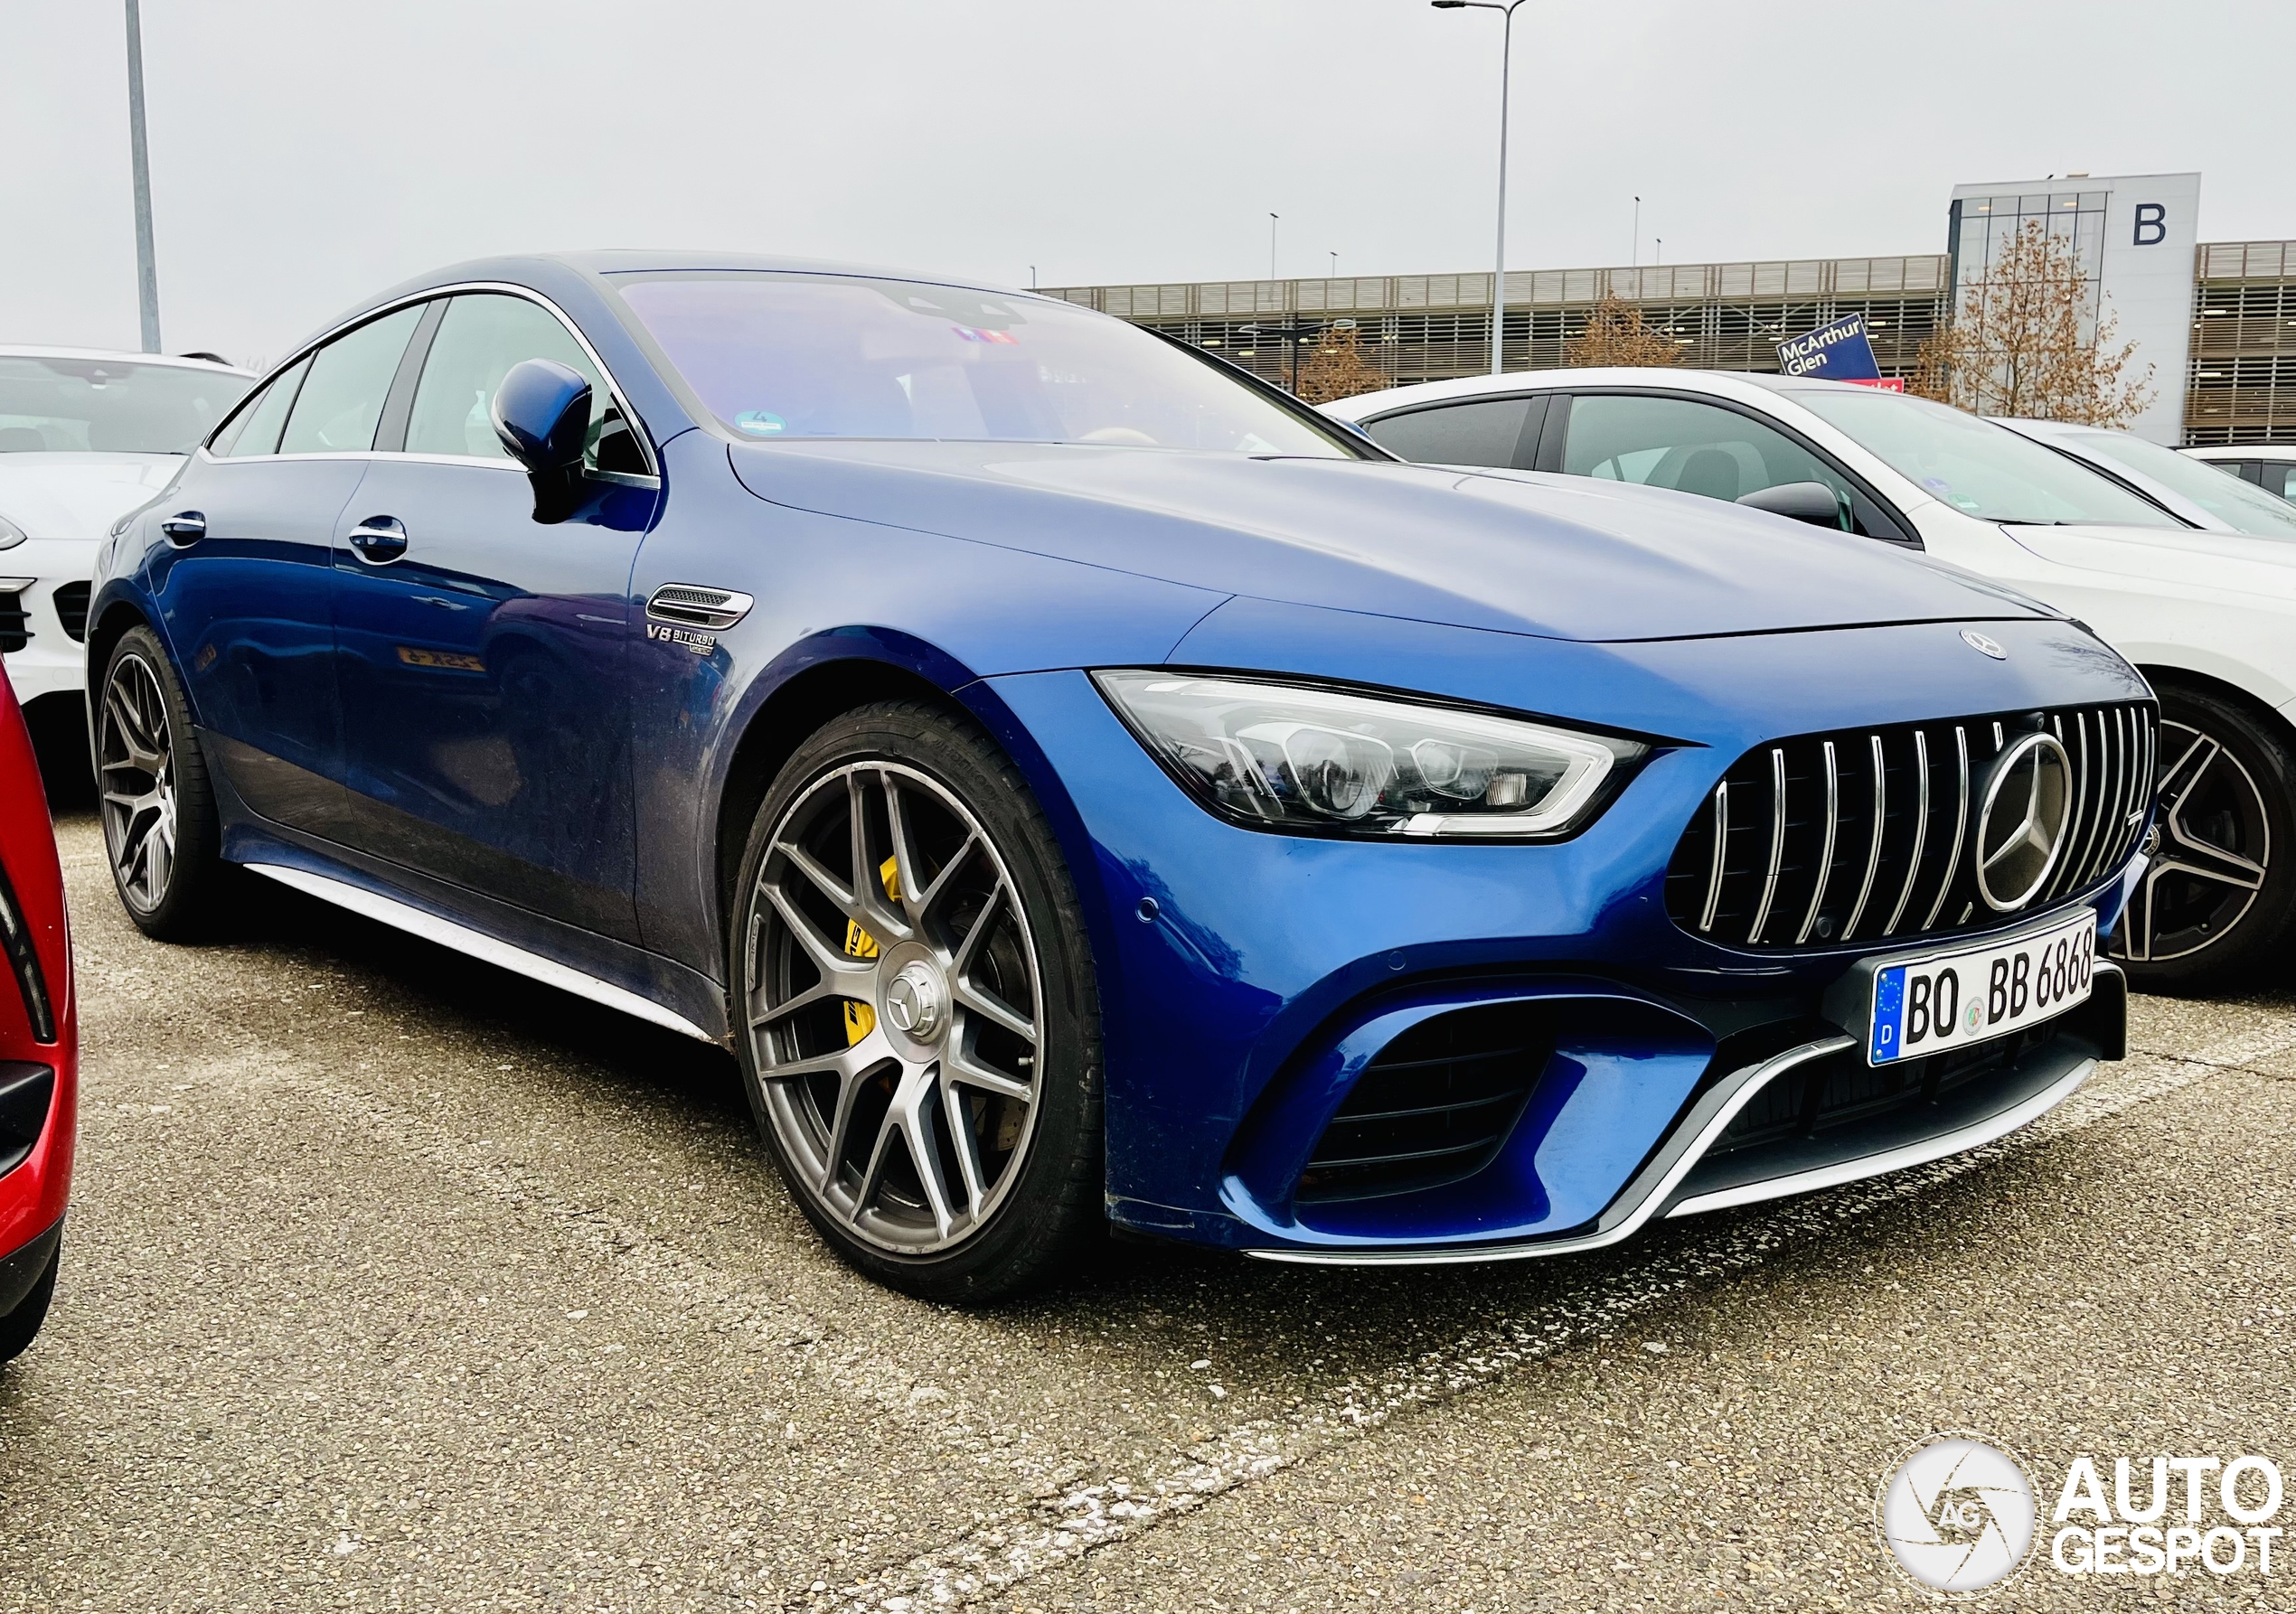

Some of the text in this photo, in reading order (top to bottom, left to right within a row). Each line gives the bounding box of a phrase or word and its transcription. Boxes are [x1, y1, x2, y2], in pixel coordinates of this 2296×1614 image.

[2133, 203, 2166, 245] B
[1782, 320, 1859, 362] McArthur
[1787, 352, 1828, 376] Glen
[752, 411, 767, 422] 4
[646, 624, 716, 646] V8 BITURBO
[1906, 967, 1959, 1045] BO
[1988, 952, 2030, 1025] BB
[2037, 925, 2093, 1009] 6868
[1881, 1024, 1893, 1045] D
